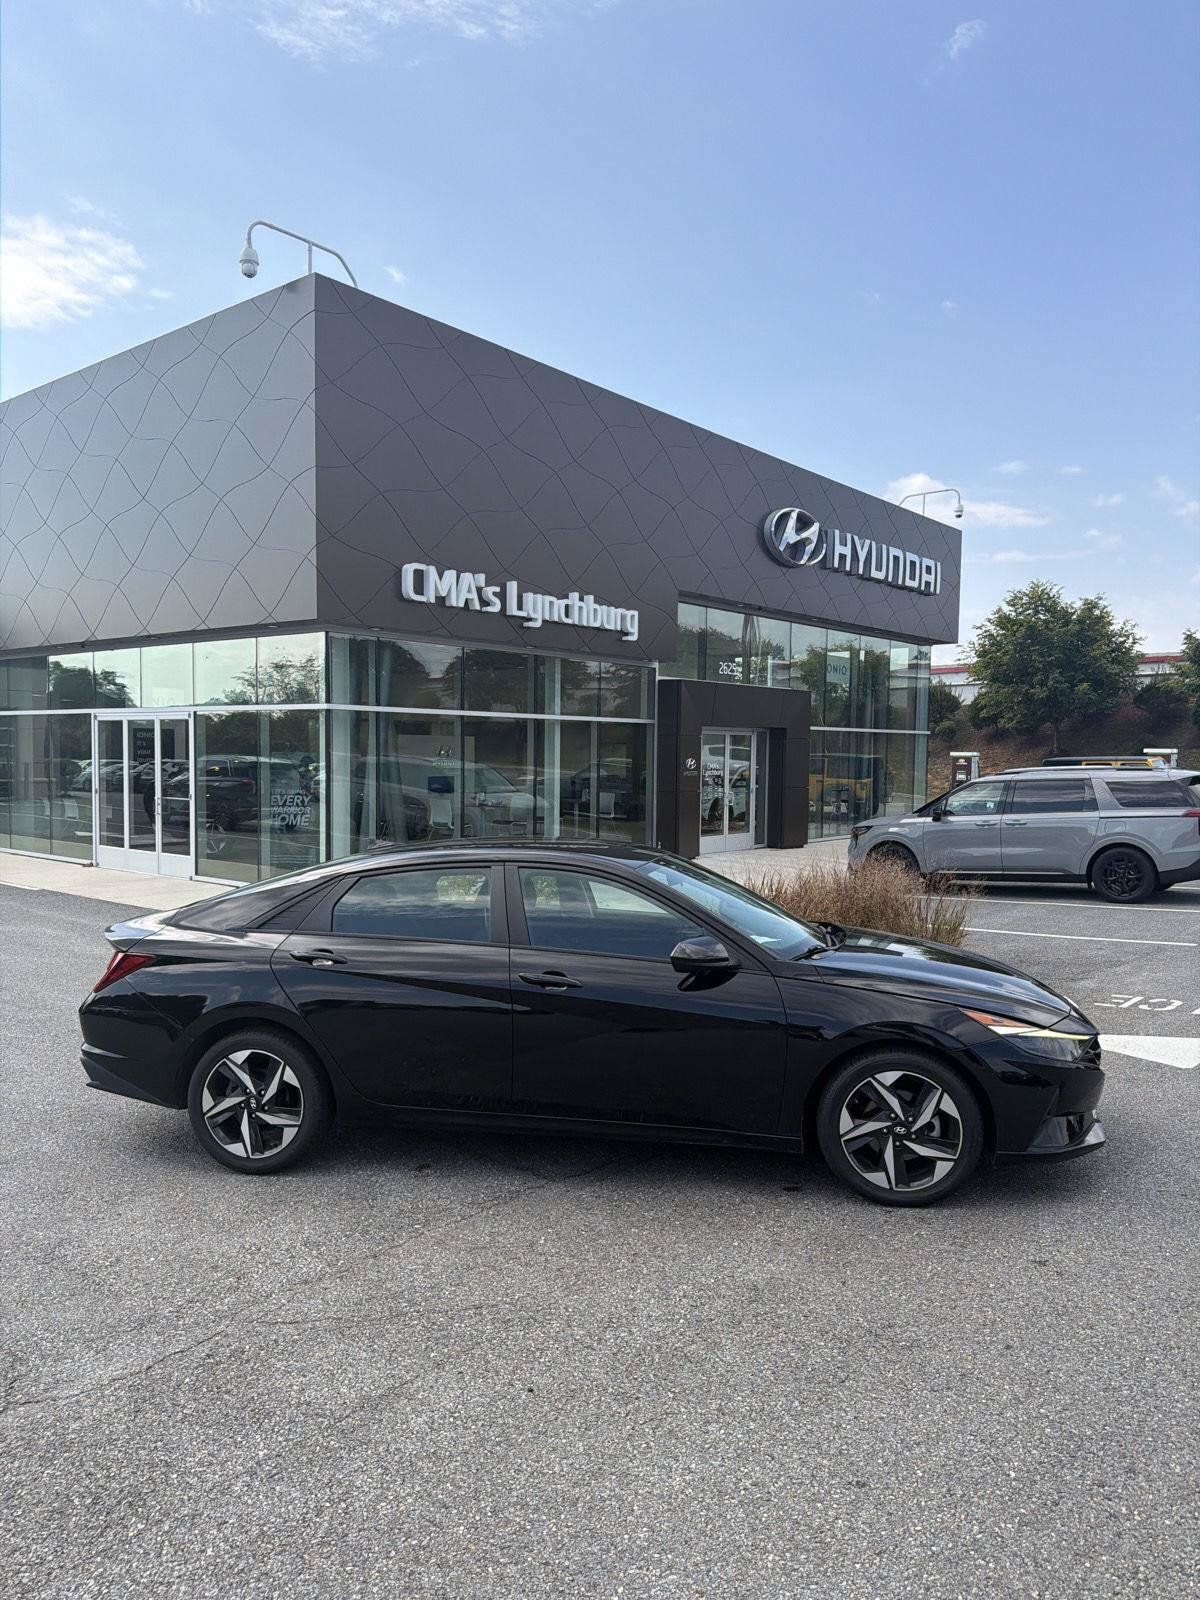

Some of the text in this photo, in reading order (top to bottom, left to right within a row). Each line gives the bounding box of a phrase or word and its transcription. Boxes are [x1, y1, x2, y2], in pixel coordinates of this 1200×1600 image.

[828, 529, 941, 595] HYUNDAI
[401, 562, 639, 641] CMA's Lynchburg
[719, 661, 737, 676] 2625
[271, 794, 312, 806] EVERY
[271, 813, 311, 826] HOME
